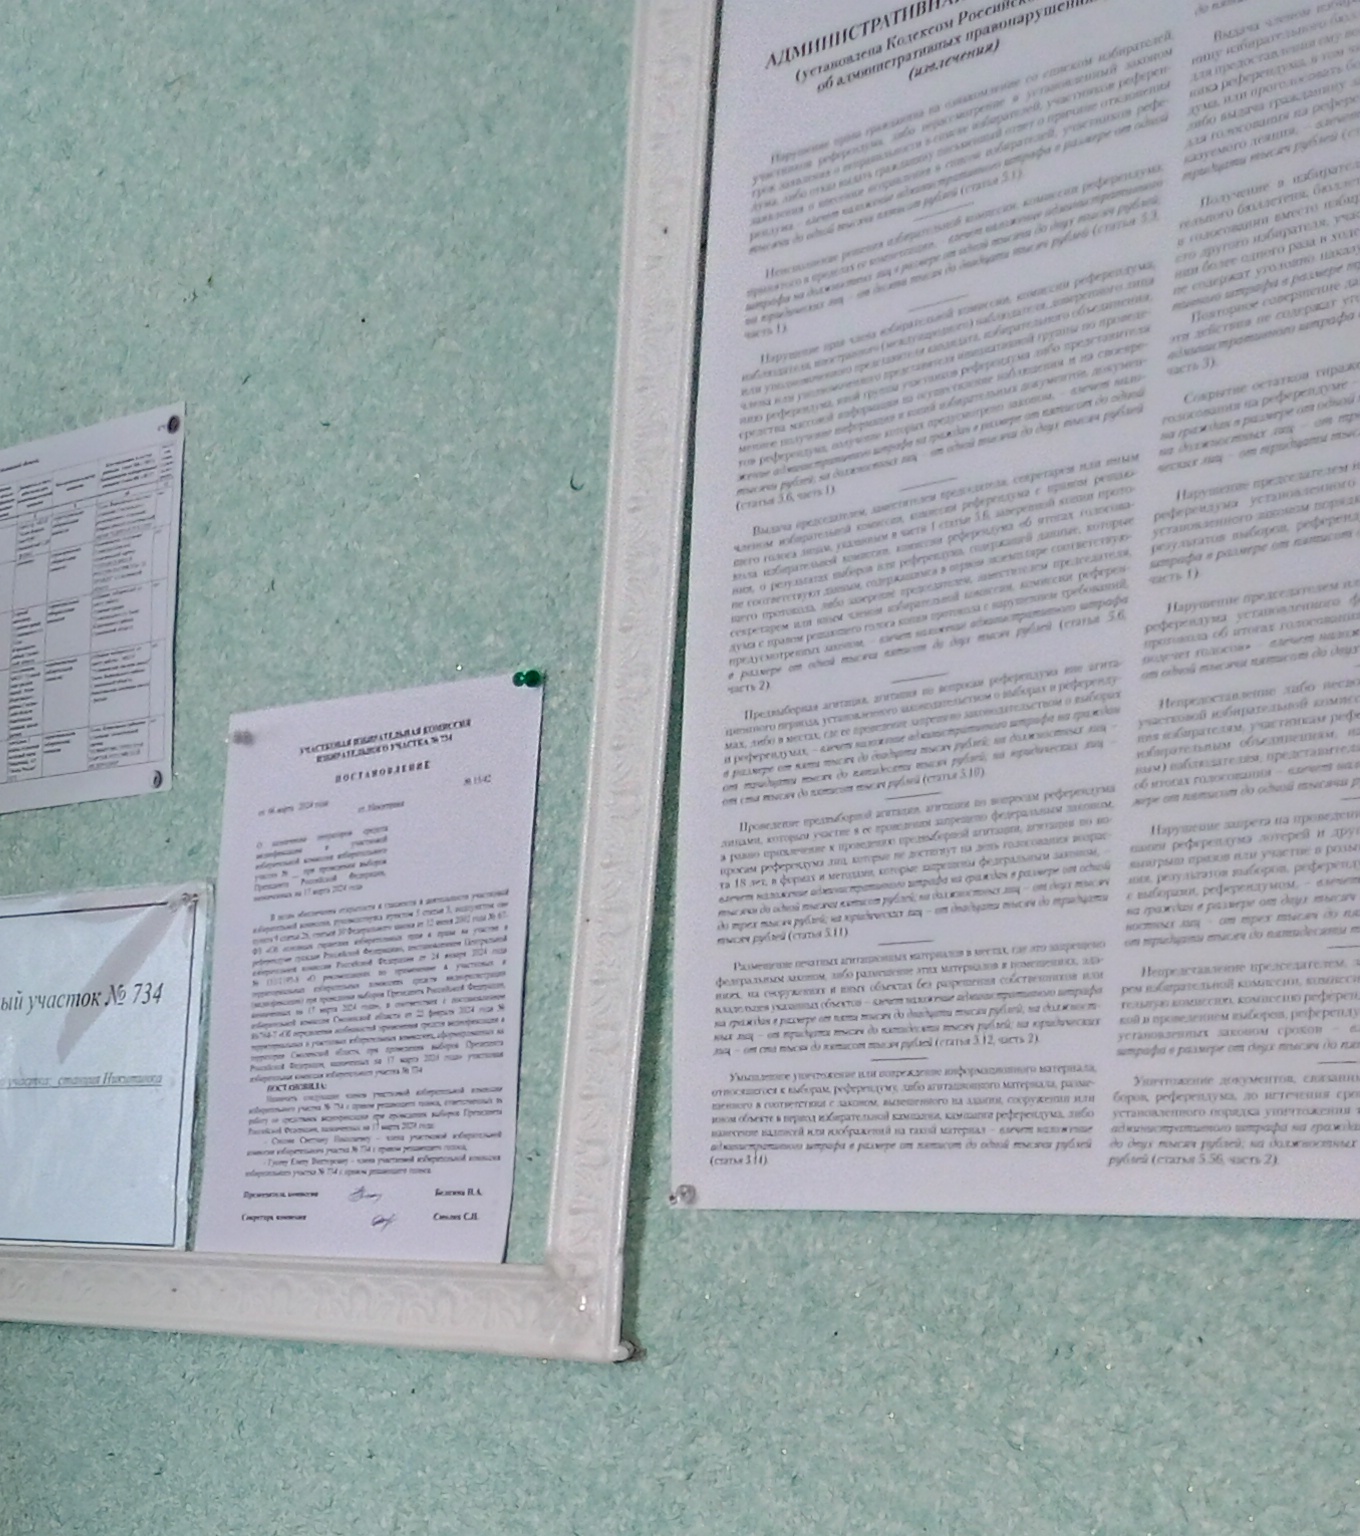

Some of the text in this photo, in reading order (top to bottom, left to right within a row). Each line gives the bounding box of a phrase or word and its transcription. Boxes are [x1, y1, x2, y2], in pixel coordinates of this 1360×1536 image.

[765, 0, 972, 70] АДМИНИСТРАТИВНА
[886, 17, 954, 51] Кодексом
[27, 991, 102, 1015] участок
[105, 984, 127, 1007] №
[131, 982, 165, 1005] 734
